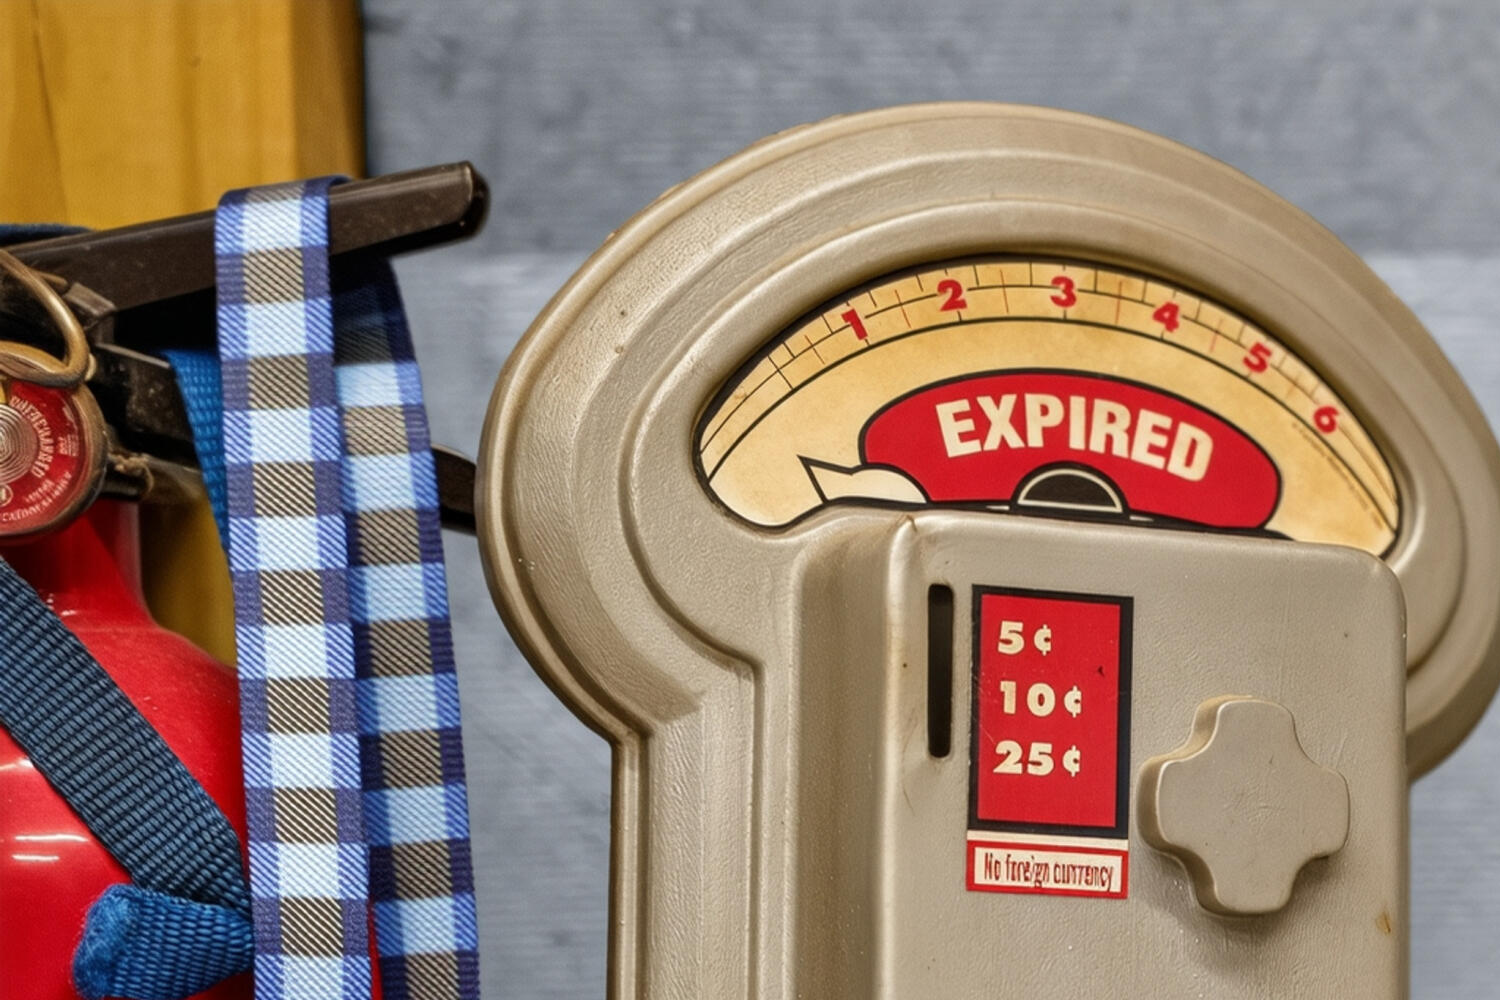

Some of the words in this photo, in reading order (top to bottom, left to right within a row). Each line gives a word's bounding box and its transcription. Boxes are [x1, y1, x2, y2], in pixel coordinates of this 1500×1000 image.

[840, 308, 869, 341] 1
[937, 279, 968, 312] 2
[1049, 275, 1077, 308] 3
[1152, 301, 1180, 333] 4
[1242, 341, 1272, 374] 5
[1313, 405, 1340, 434] 6
[935, 393, 1214, 482] EXPIRED
[997, 620, 1052, 656] 5¢
[1000, 680, 1083, 718] 10¢
[993, 740, 1081, 778] 25¢
[984, 852, 1001, 881] No
[1005, 853, 1050, 889] foreign
[1053, 862, 1114, 893] currency
